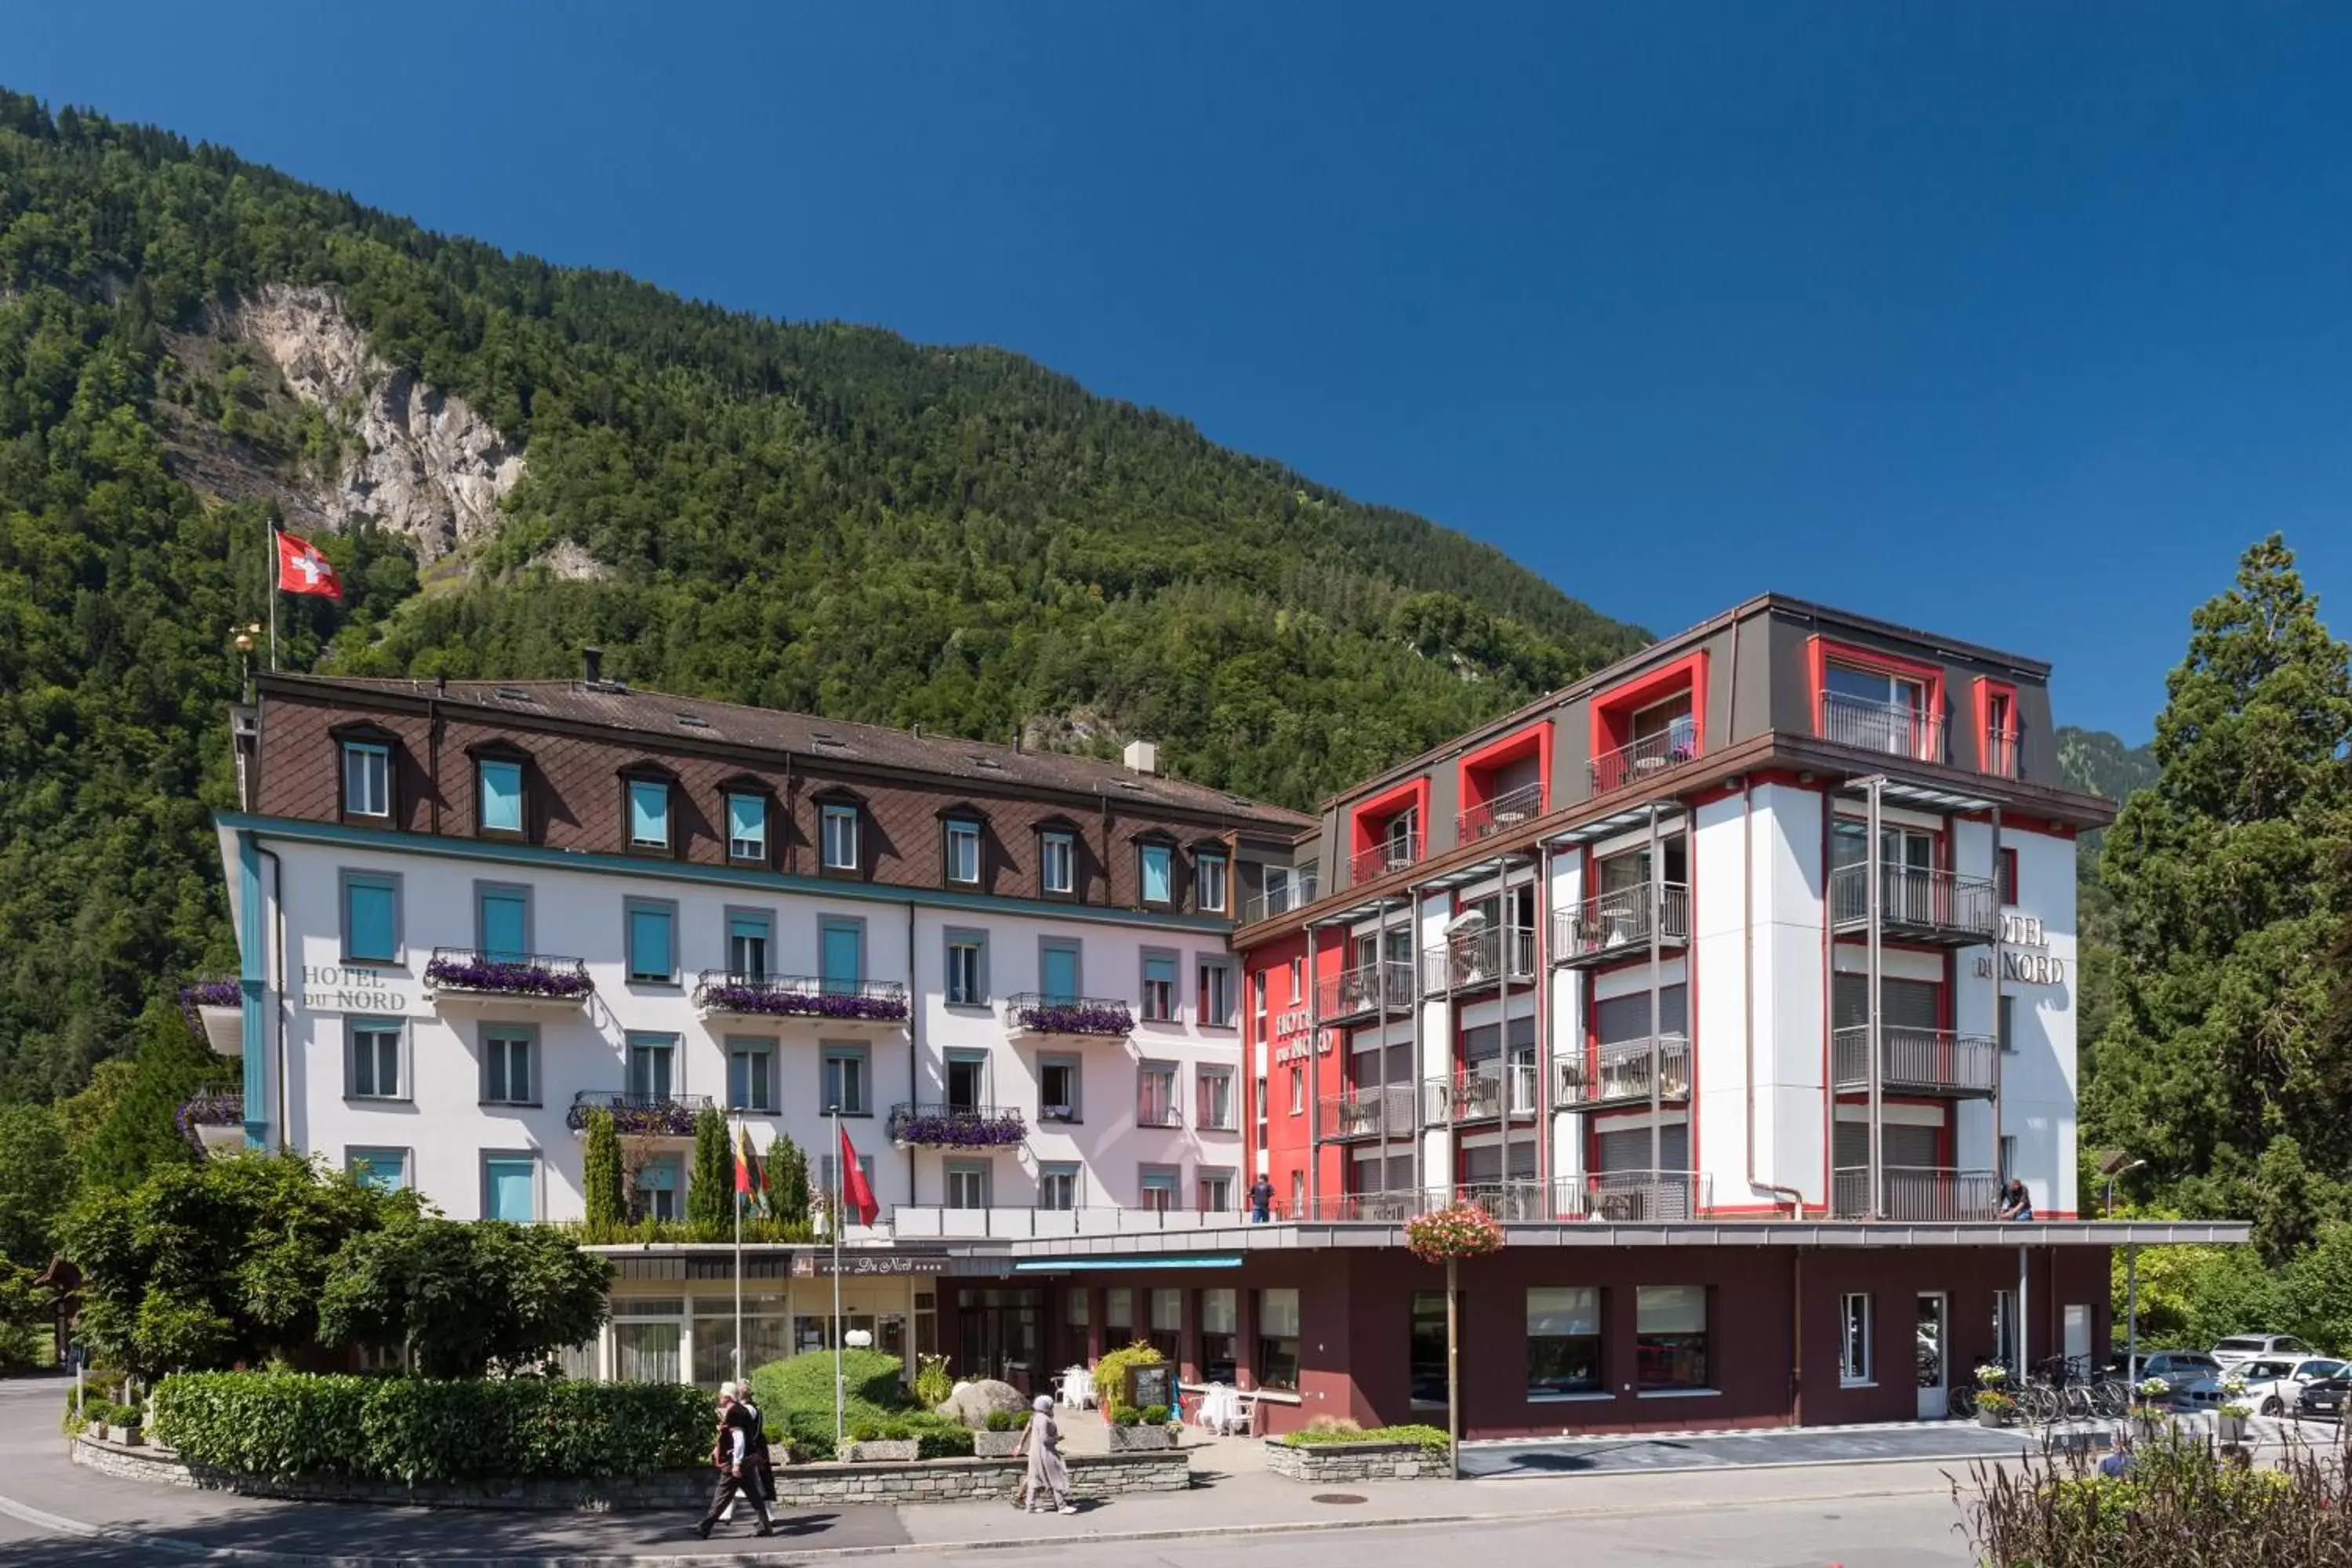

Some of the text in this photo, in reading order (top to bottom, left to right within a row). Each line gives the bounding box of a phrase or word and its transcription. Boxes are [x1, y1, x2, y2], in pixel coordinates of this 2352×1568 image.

[302, 965, 384, 989] HOTEL
[2003, 951, 2064, 985] NORD
[303, 990, 406, 1011] DU NORD
[1276, 1008, 1313, 1036] HOT
[854, 1256, 912, 1274] Du Nord
